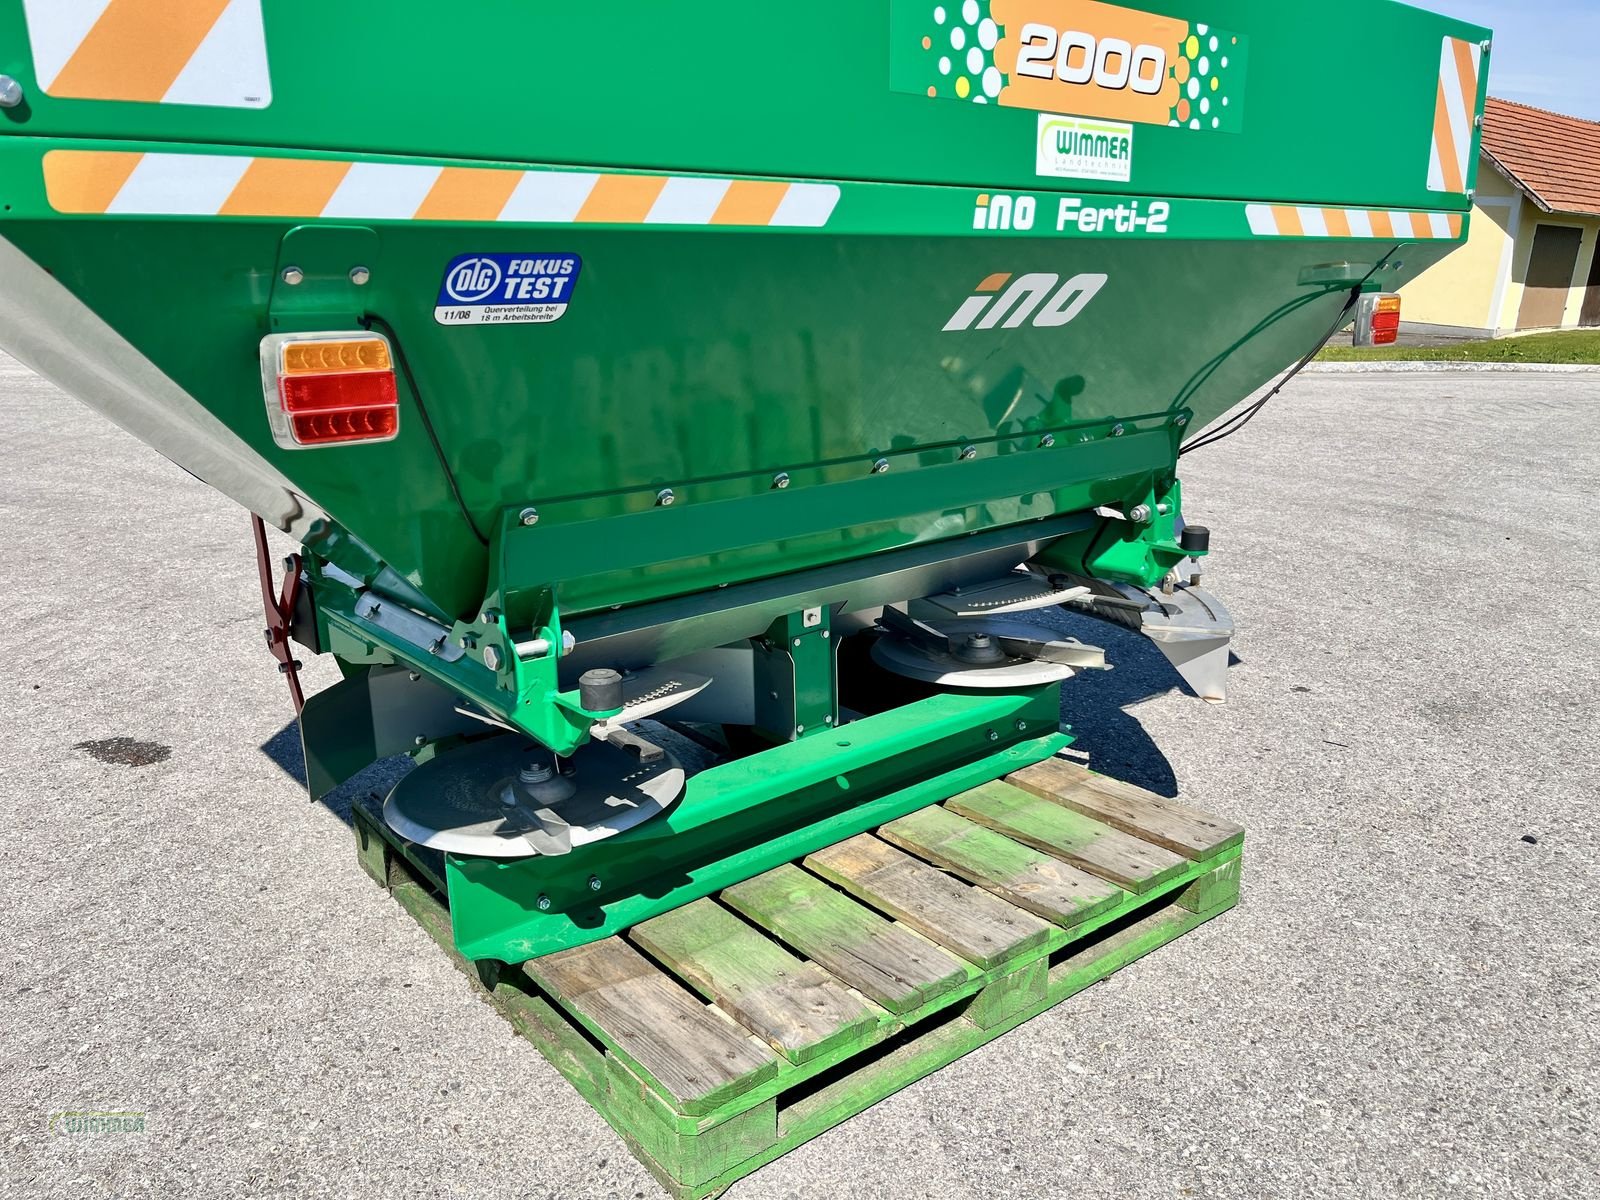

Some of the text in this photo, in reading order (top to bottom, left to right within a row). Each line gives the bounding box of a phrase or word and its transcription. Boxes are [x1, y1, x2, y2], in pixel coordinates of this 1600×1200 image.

[1016, 23, 1166, 95] 2000
[1056, 130, 1129, 160] WIMMER
[1056, 197, 1170, 233] Ferti-2
[456, 261, 493, 292] DLG
[507, 259, 575, 276] FOKUS
[504, 277, 569, 299] TEST
[444, 310, 471, 320] 11/08
[484, 306, 544, 314] Querverteilung
[503, 313, 554, 321] Arbeitsbreite
